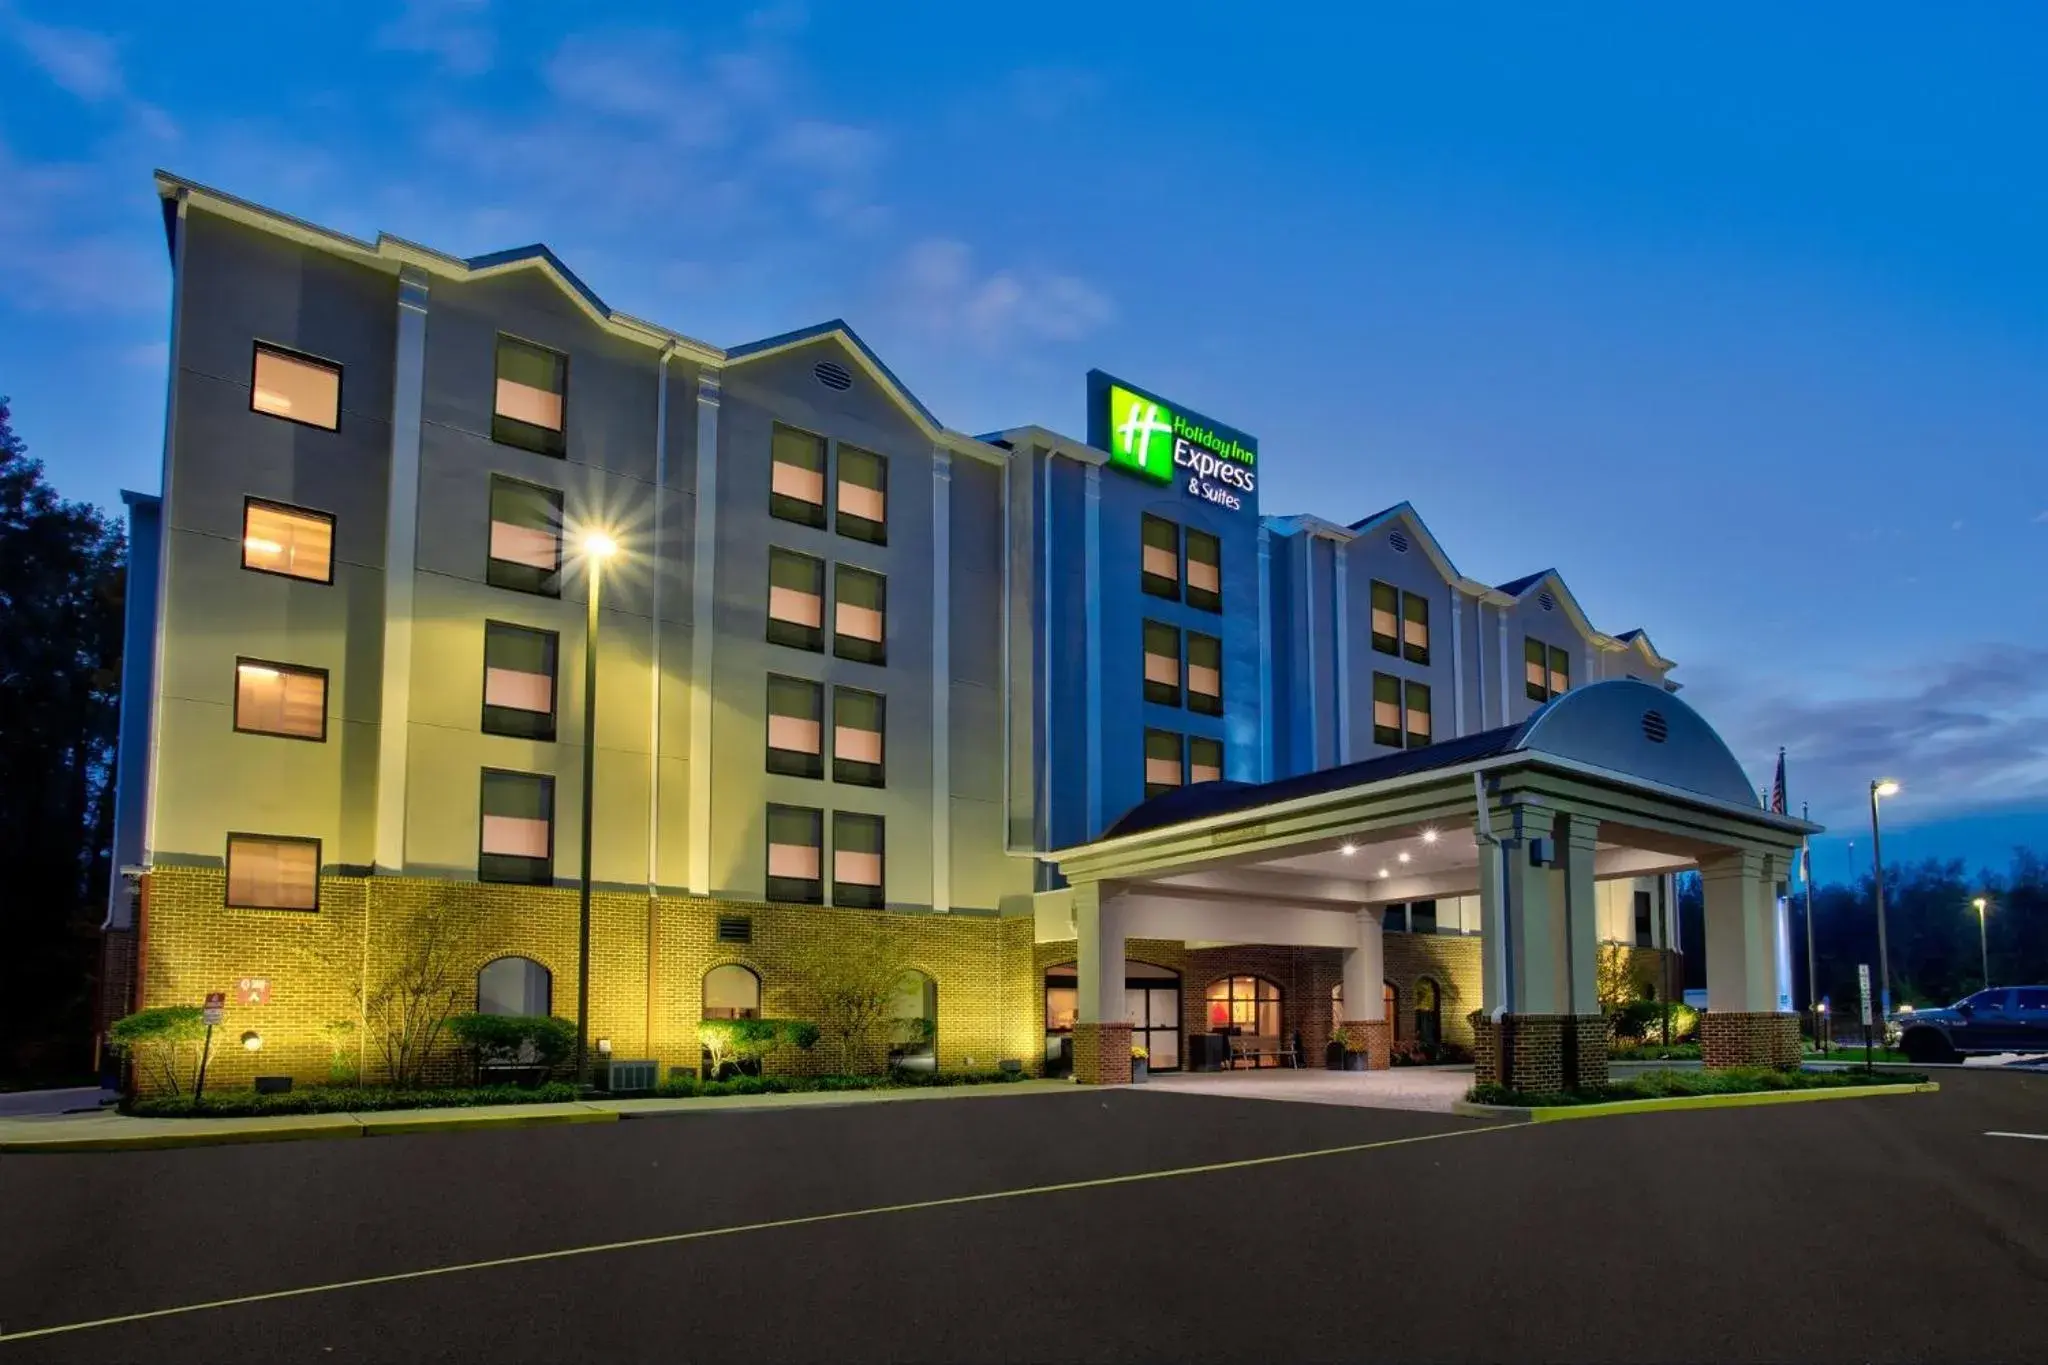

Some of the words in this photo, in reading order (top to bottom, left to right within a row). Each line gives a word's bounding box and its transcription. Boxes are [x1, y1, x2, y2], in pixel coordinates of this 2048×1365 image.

[1174, 415, 1230, 458] Holiday
[1231, 440, 1254, 465] Inn
[1174, 438, 1255, 491] Express
[1188, 477, 1199, 496] &
[1201, 482, 1241, 510] Suites
